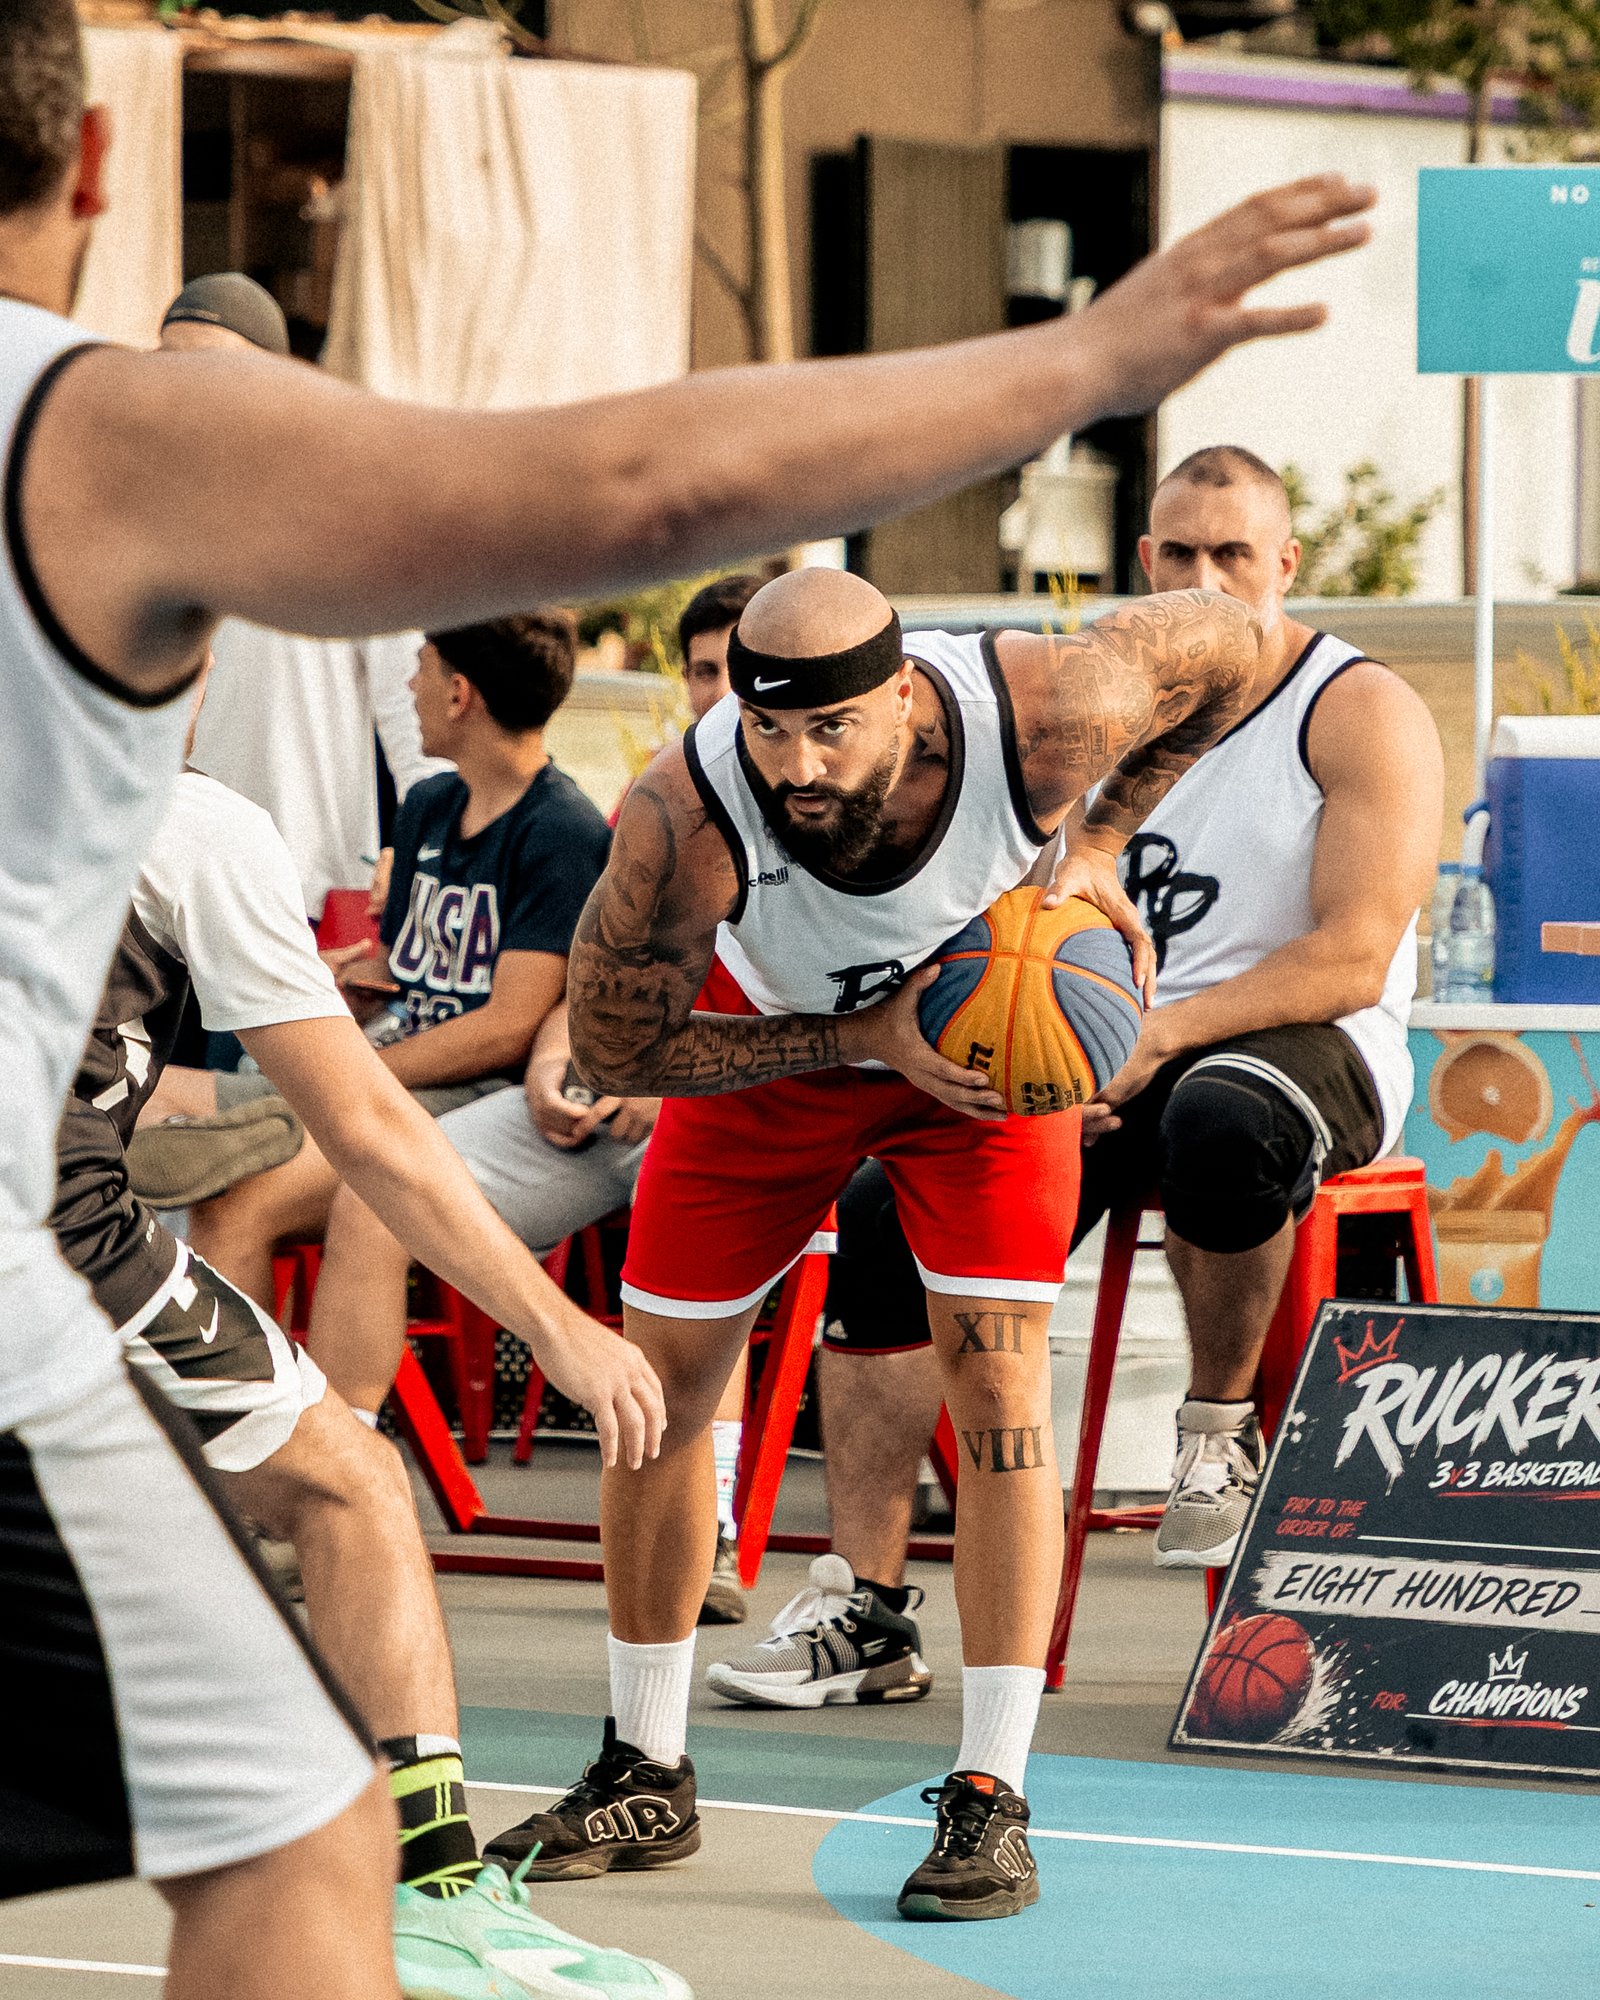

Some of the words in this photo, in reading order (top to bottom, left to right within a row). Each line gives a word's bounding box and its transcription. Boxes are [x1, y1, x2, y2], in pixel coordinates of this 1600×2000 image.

[1550, 184, 1590, 206] NO
[388, 871, 501, 993] USA
[953, 1311, 1027, 1355] XII
[961, 1426, 1046, 1472] VIII
[1275, 1519, 1330, 1537] ORDER
[1281, 1496, 1316, 1514] PAY
[1314, 1498, 1336, 1516] TO
[1336, 1500, 1368, 1518] THE
[1274, 1563, 1397, 1606] EIGHT
[1391, 1570, 1581, 1618] HUNDRED
[584, 1794, 681, 1843] AIR
